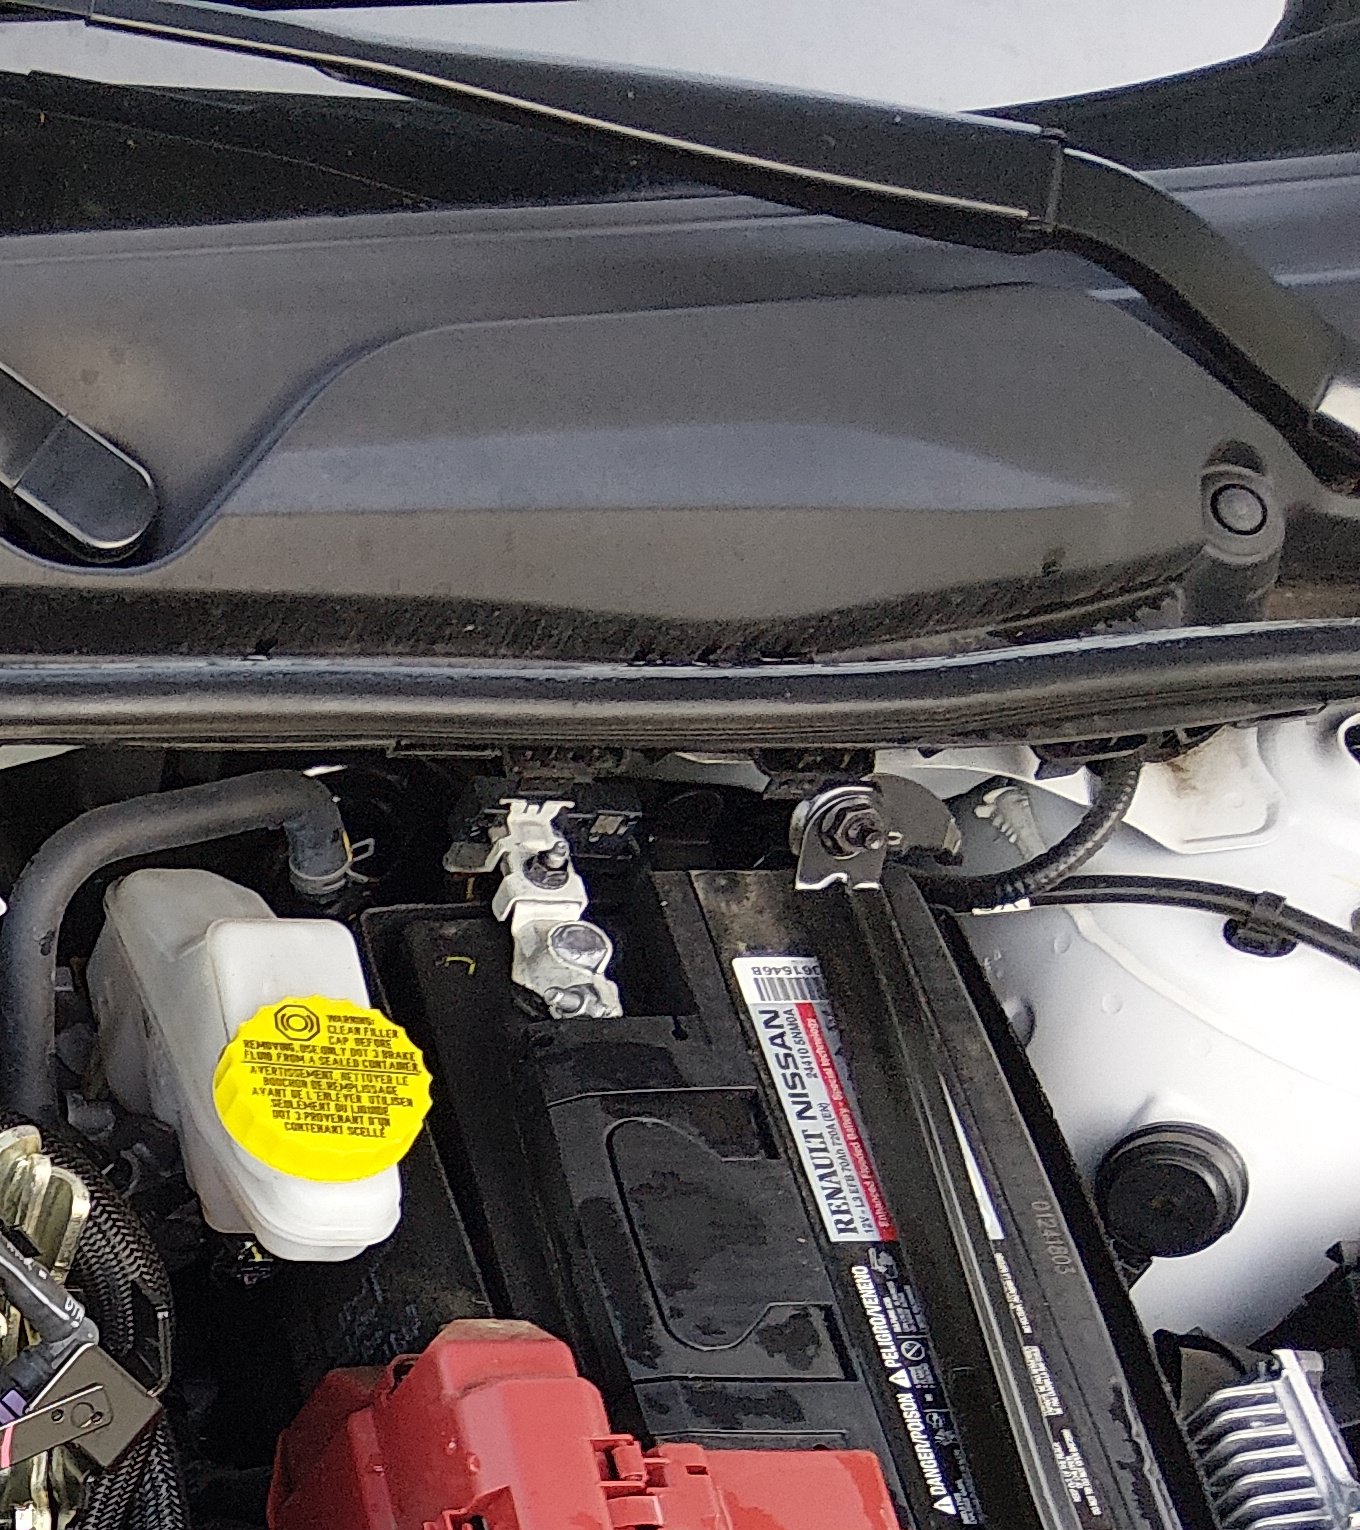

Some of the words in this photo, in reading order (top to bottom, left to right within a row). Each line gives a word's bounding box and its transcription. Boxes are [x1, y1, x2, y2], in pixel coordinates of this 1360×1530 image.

[327, 1025, 360, 1035] CLEAN
[364, 1027, 399, 1038] FILLER
[329, 1036, 349, 1045] CAP
[244, 1049, 272, 1061] FLUID
[277, 1052, 304, 1063] FROM
[309, 1055, 315, 1064] A
[318, 1056, 359, 1068] SEALED
[350, 1048, 369, 1057] DOT
[381, 1051, 415, 1062] BRAKE
[759, 1010, 817, 1121] NISSAN
[797, 1048, 819, 1079] 24410
[311, 1080, 324, 1089] DE
[396, 1076, 409, 1086] LE
[252, 1087, 286, 1097] AVANT
[291, 1090, 303, 1099] DE
[272, 1110, 290, 1119] DOT
[304, 1112, 363, 1124] PROVENANT
[284, 1122, 343, 1135] CONTENANT
[802, 1129, 859, 1234] RENAULT
[863, 1181, 890, 1227] Enhanced
[859, 1216, 874, 1233] 12V
[851, 1265, 902, 1368] PELIGRO/VENENO
[896, 1392, 948, 1496] DANGER/POISON
